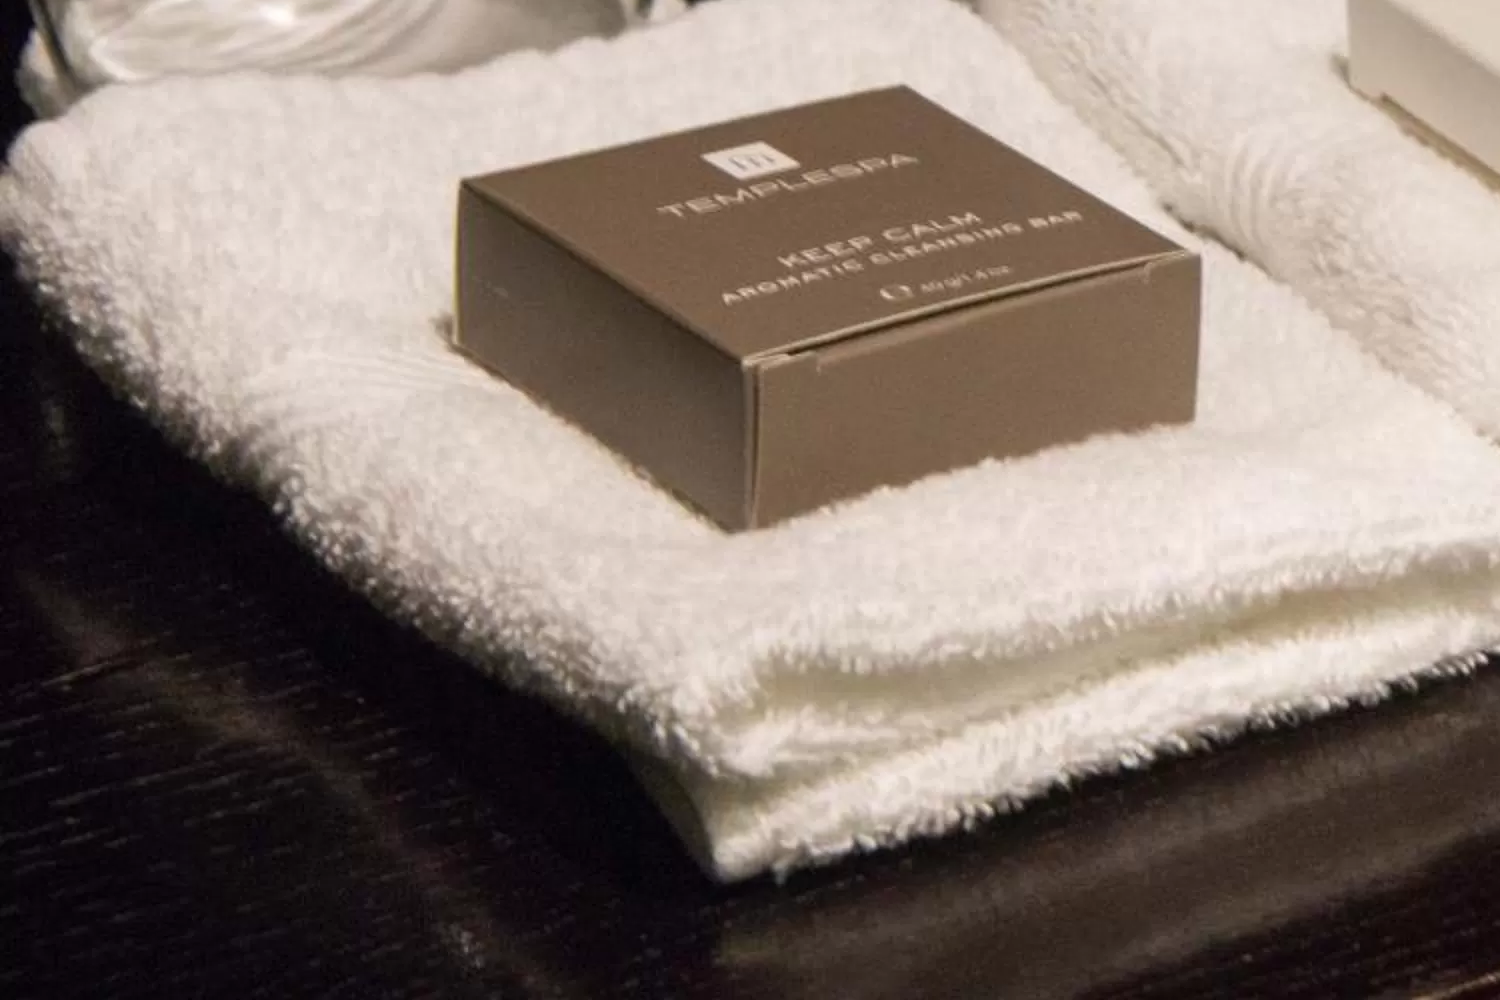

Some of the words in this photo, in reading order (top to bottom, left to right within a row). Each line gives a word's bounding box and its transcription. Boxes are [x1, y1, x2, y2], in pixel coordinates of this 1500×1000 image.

[657, 152, 919, 217] TEMPLESPA
[721, 258, 865, 305] AROMATIC
[1028, 209, 1083, 229] BAR
[777, 235, 872, 269] KEEP
[883, 211, 984, 243] CALM
